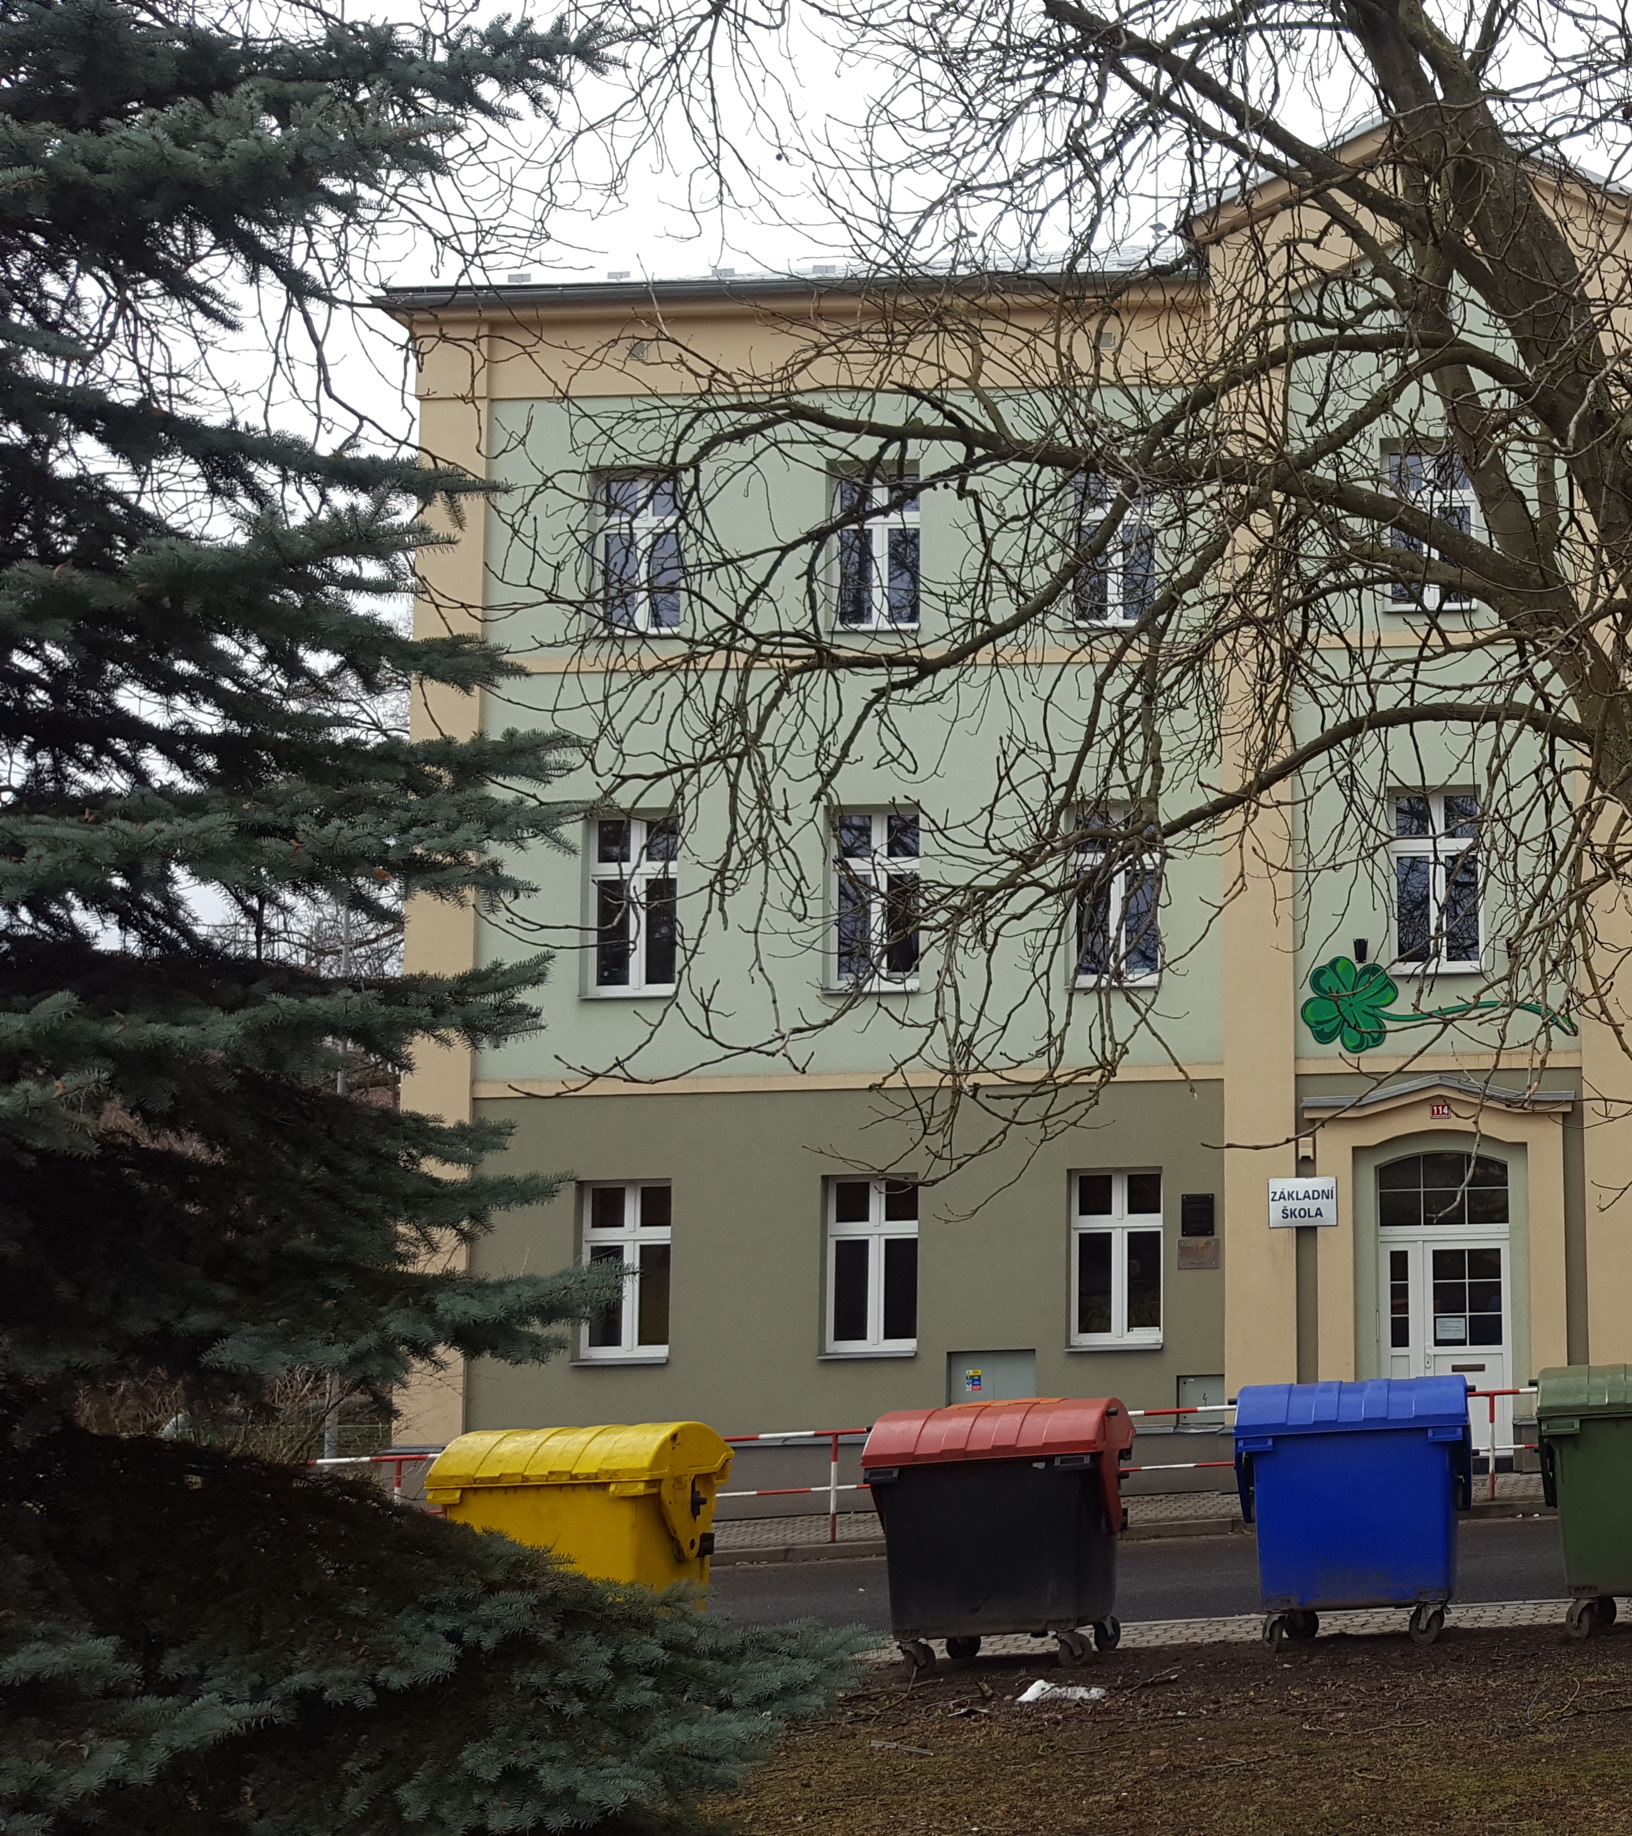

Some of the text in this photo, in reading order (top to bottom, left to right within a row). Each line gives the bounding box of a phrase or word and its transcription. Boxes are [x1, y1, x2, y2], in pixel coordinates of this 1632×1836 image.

[1433, 1105, 1448, 1115] 114
[1270, 1186, 1334, 1202] ZÁKLADNÍ
[1281, 1205, 1323, 1219] ŠKOLA
